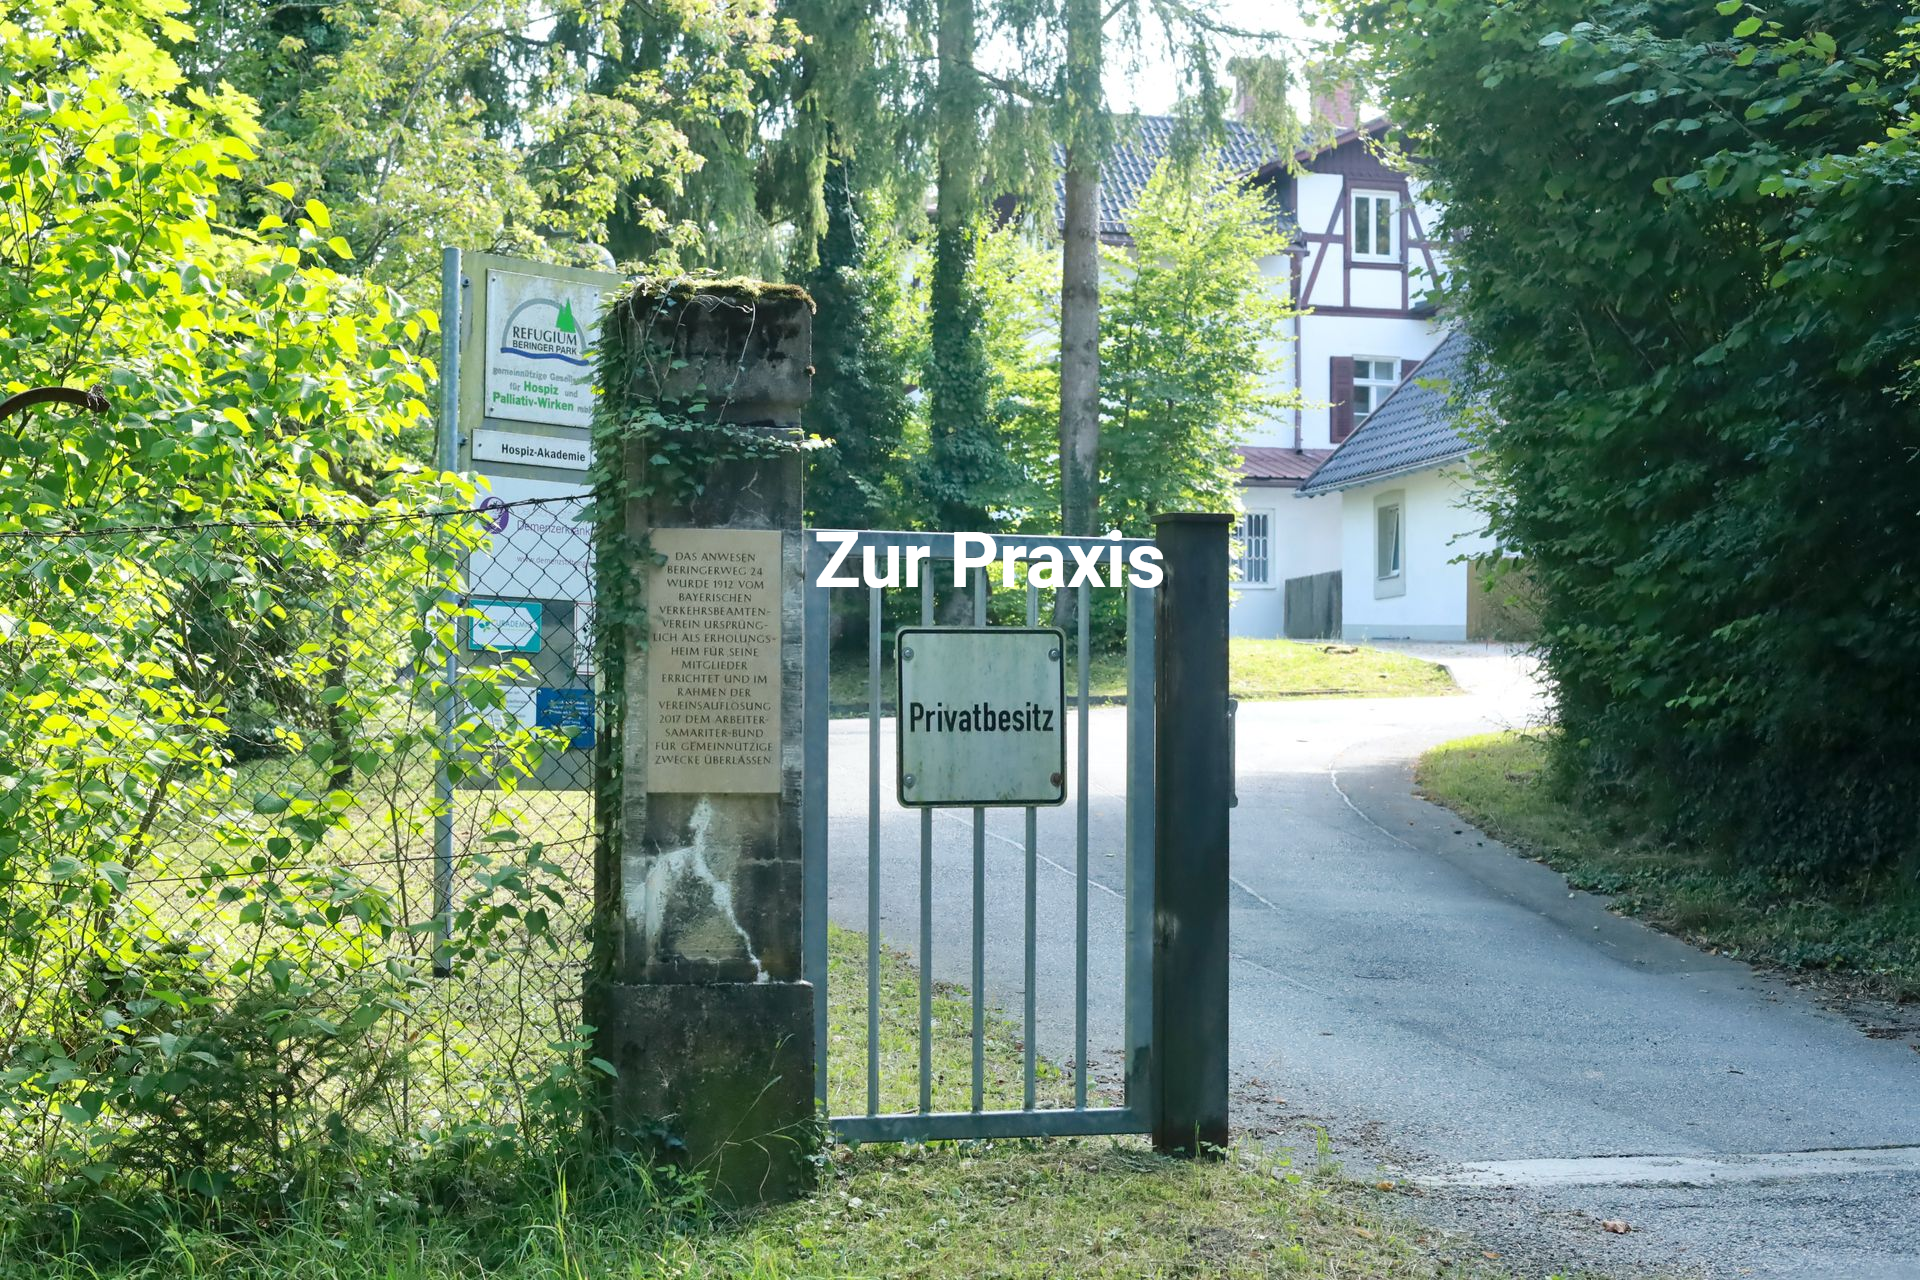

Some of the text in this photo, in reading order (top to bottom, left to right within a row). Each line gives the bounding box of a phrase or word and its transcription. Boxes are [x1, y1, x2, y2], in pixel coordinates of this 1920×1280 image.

[512, 326, 577, 346] REFUGIUM
[512, 340, 577, 355] BERINGER PARK
[492, 367, 547, 380] gemeinnützige
[509, 380, 578, 398] für Hospiz und
[492, 391, 574, 411] Palliativ-Wirken
[501, 443, 586, 462] Hospiz-Akademie
[675, 552, 756, 562] DAS ANWESEN
[667, 565, 763, 576] BERINGERWEG 24
[666, 578, 764, 590] WURDE 1912 VOM
[678, 592, 752, 602] BAYERISCHEN
[659, 605, 771, 616] VERKEHRSBEAMTEN-
[662, 619, 768, 630] VEREIN URSPRÜNG-
[652, 632, 777, 643] LICH ALS ERHOLUNGS-
[671, 646, 759, 657] HEIM FÜR SEINE
[681, 660, 748, 670] MITGLIEDER
[661, 674, 767, 684] ERRICHTET UND IM
[677, 687, 751, 697] RAHMEN DER
[658, 714, 769, 725] 2017 DEM ARBEITER-
[910, 701, 1053, 733] Privatbesitz
[665, 728, 764, 738] SAMARITER-BUND
[655, 754, 771, 765] ZWECKE ÜBERLASSEN
